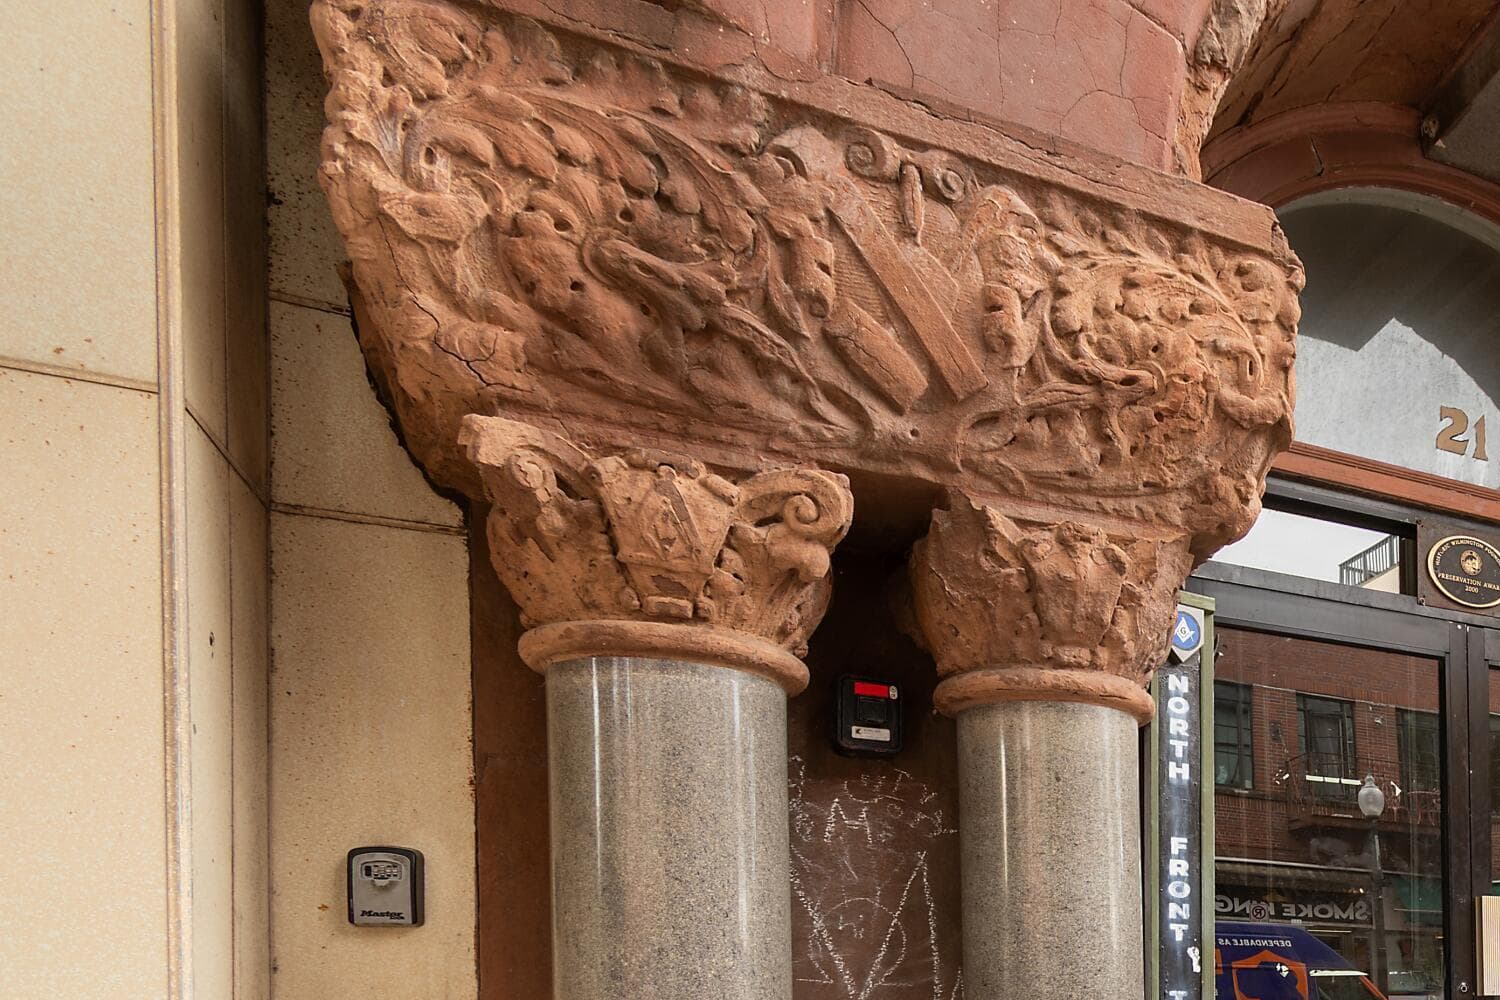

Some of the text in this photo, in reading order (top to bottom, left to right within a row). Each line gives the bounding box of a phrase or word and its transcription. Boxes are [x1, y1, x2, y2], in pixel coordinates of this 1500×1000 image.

[1435, 405, 1488, 461] 21
[1451, 540, 1484, 549] WILMINGTON
[1438, 572, 1481, 587] PRESERVATION
[1167, 674, 1190, 780] NORTH
[1168, 836, 1191, 942] FRONT
[360, 909, 404, 917] Master
